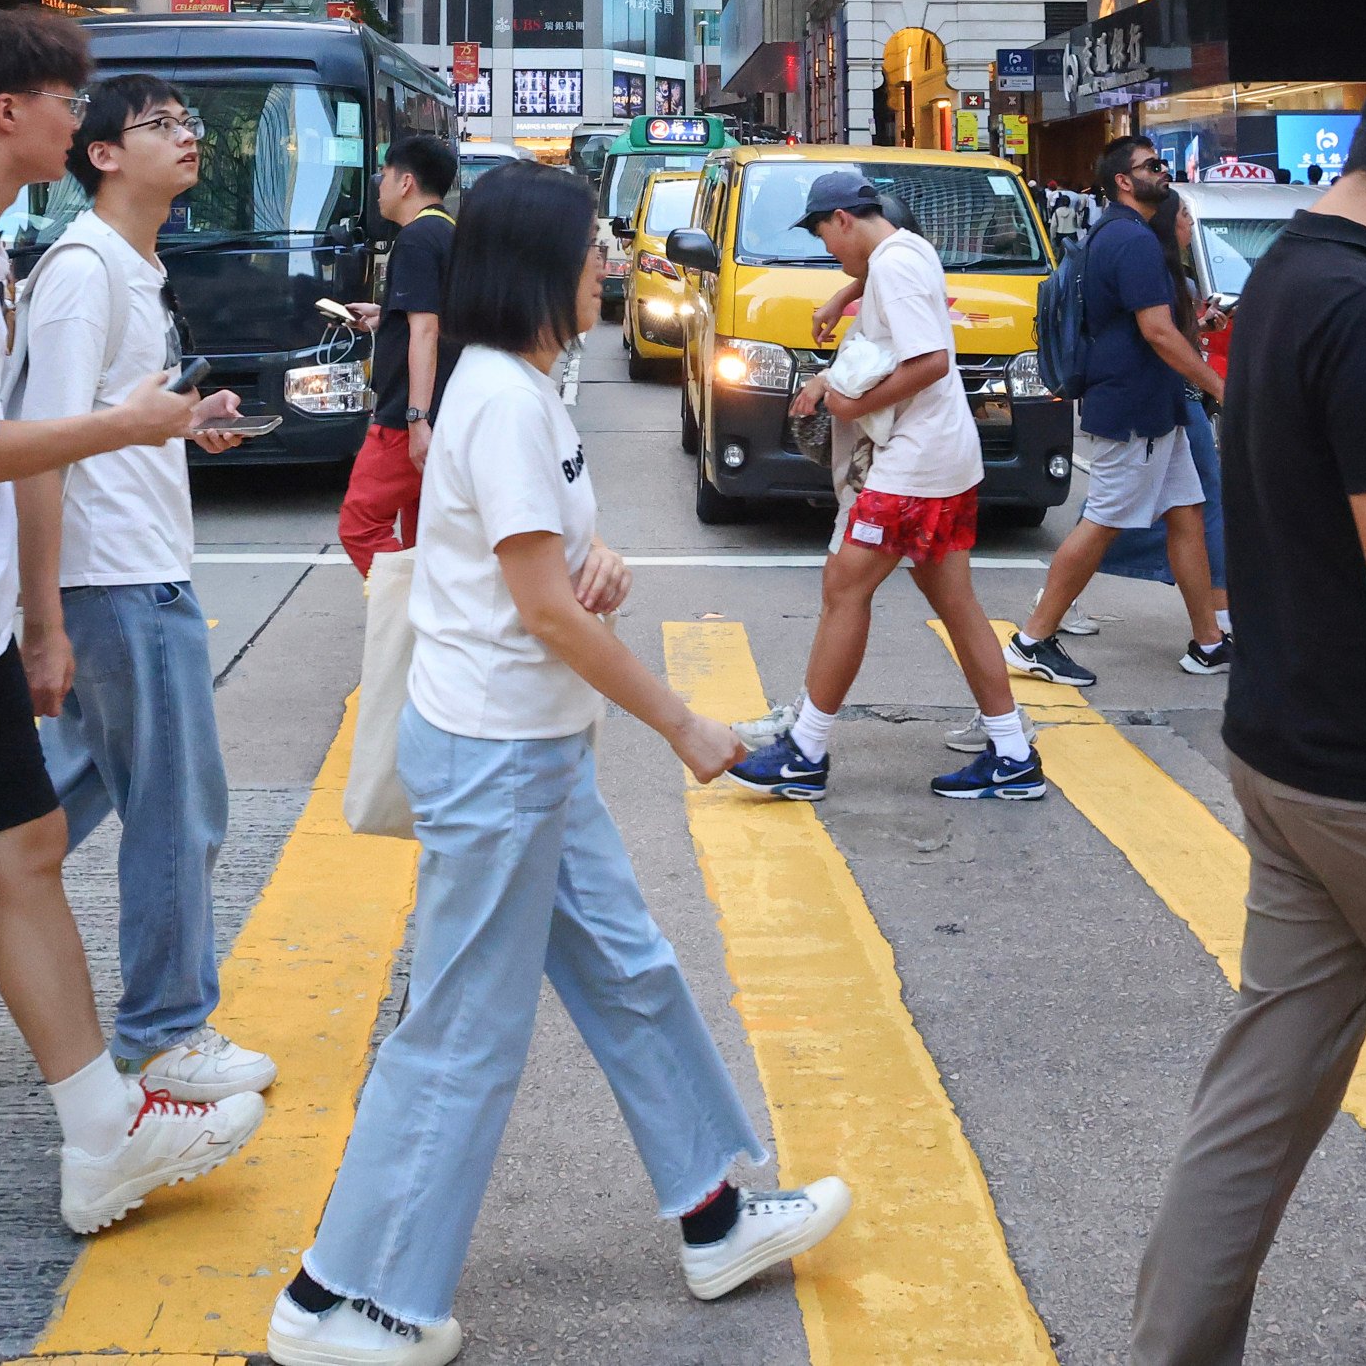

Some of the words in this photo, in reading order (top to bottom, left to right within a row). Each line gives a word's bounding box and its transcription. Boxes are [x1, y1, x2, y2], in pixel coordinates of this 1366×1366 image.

[175, 3, 225, 12] CELEBRATING
[336, 5, 354, 20] 75
[512, 18, 541, 32] UBS
[460, 44, 473, 56] 75
[653, 120, 666, 136] 2
[1217, 164, 1267, 179] TAXI
